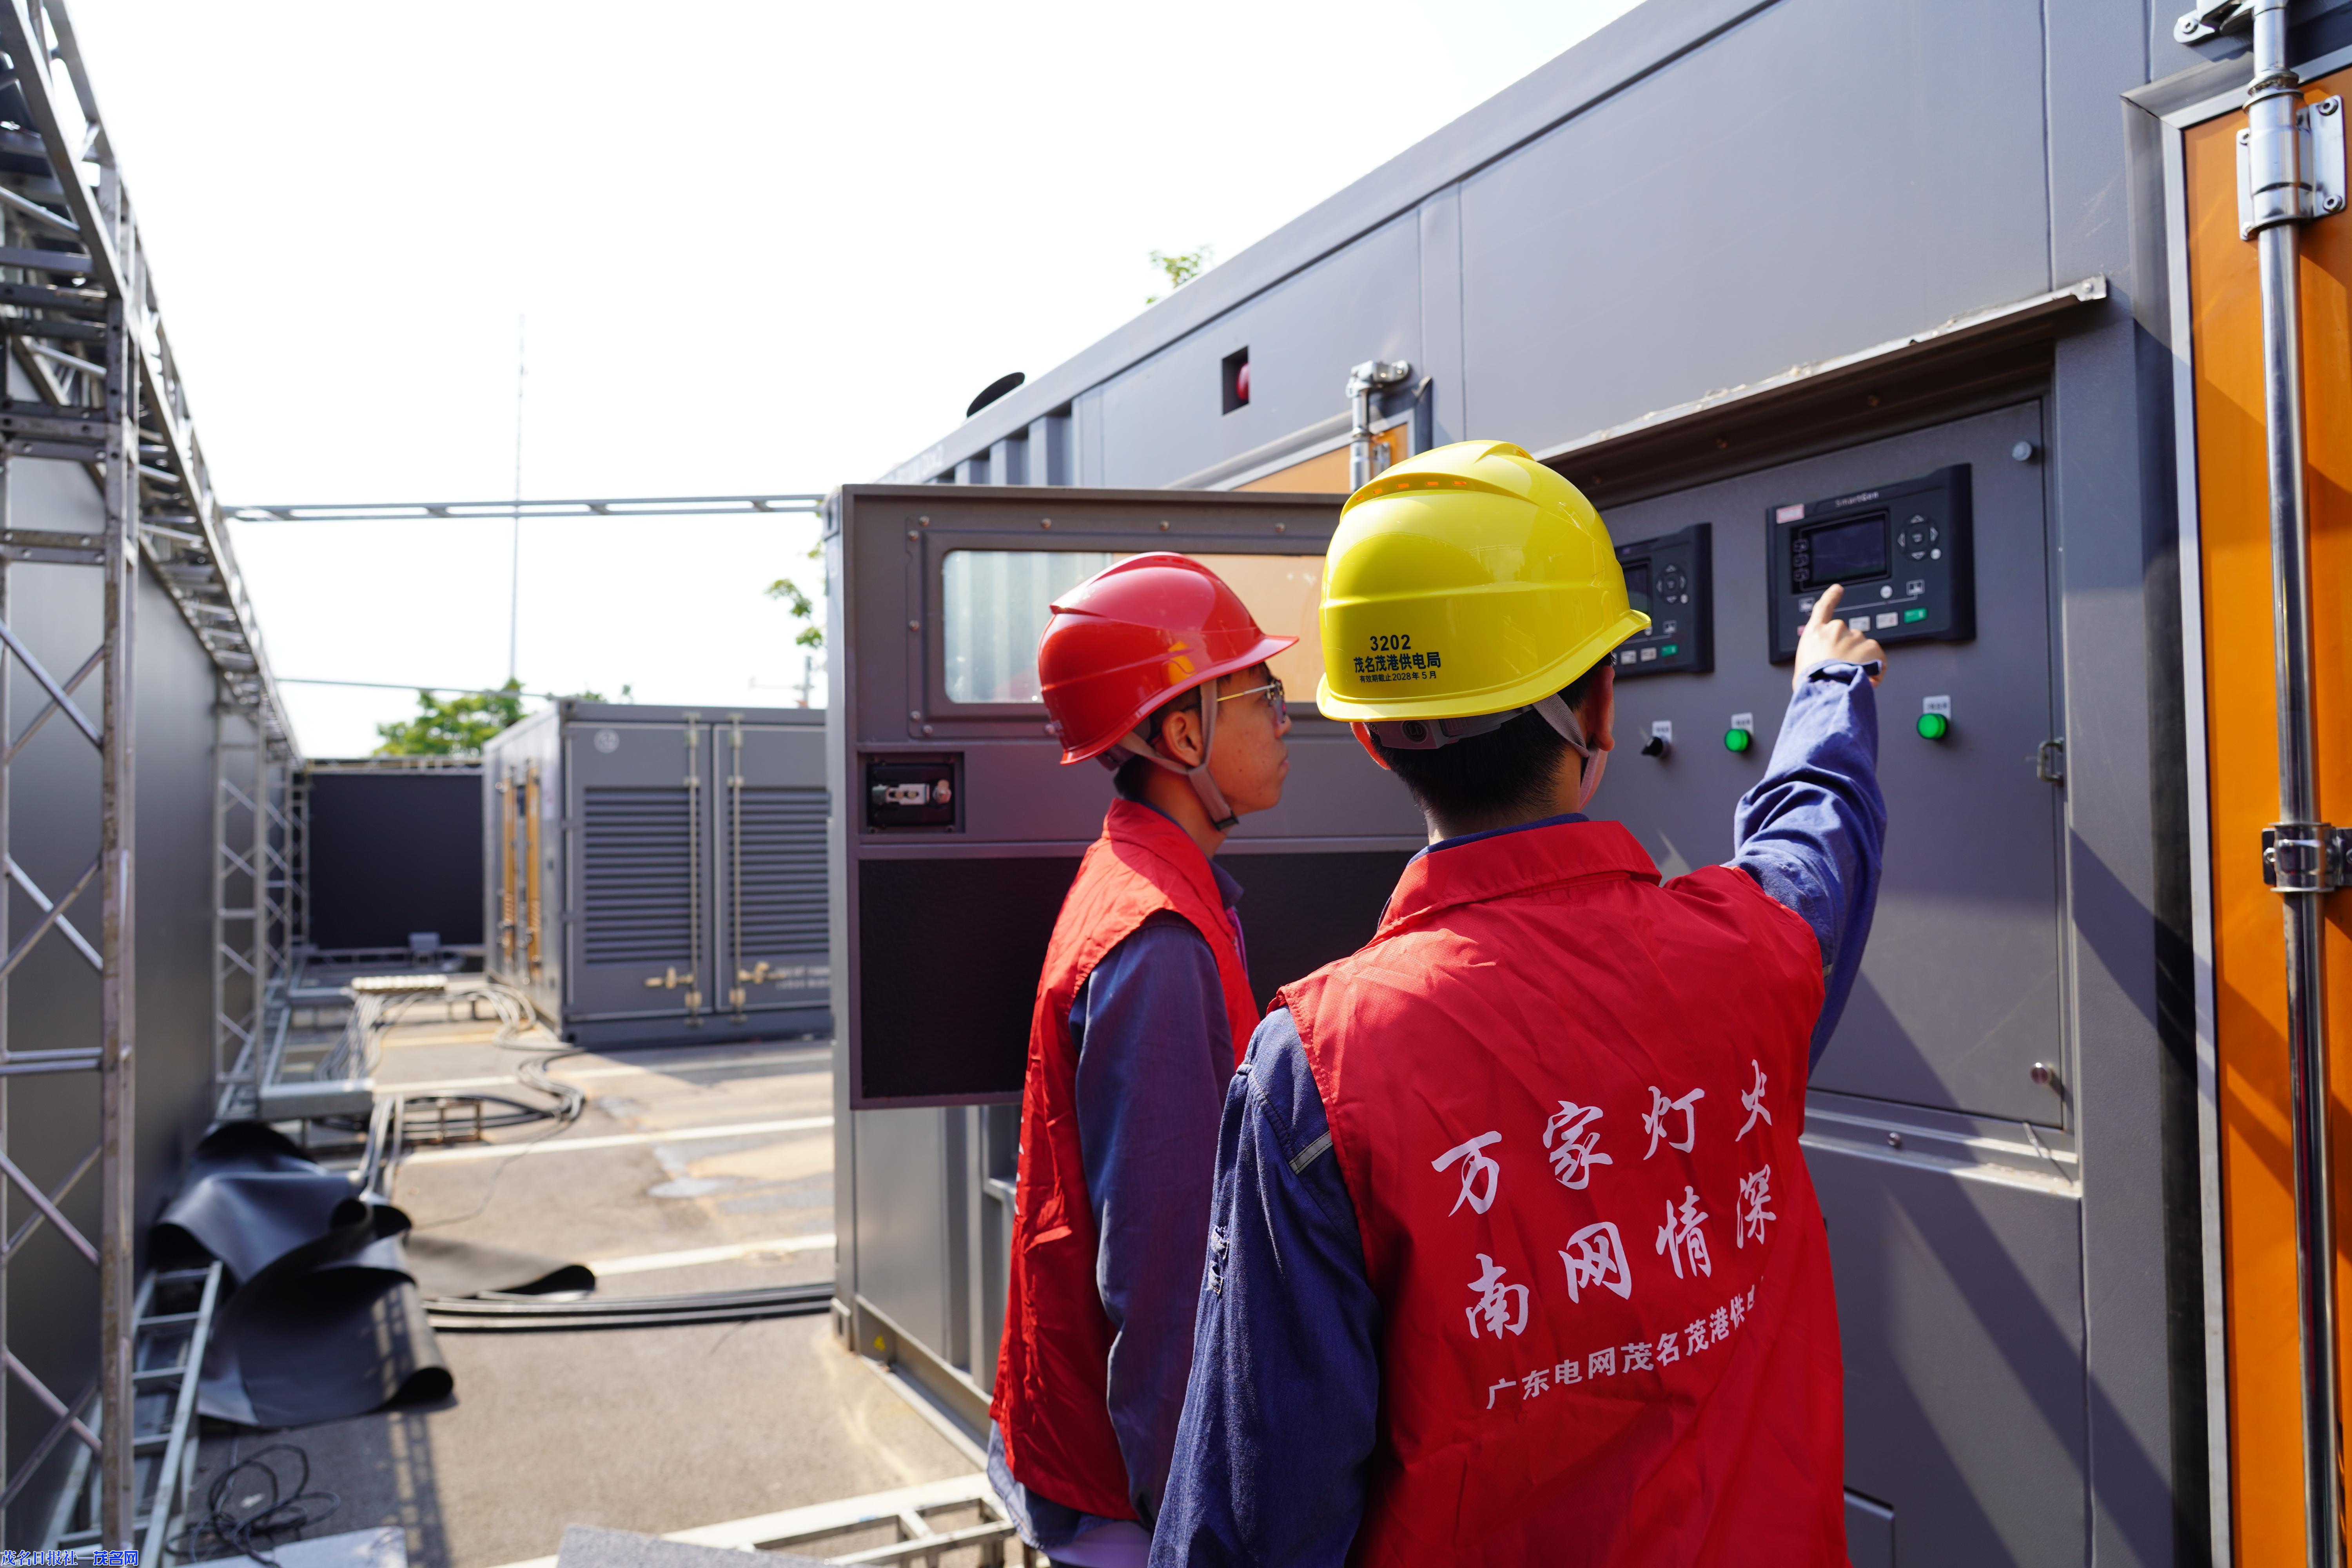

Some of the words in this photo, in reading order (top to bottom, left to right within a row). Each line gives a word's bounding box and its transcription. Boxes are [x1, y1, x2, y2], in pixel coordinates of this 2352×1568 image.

[1353, 652, 1441, 673] 茂名茂港供电局
[1370, 634, 1411, 651] 3202
[1431, 1059, 1772, 1217] 万家灯火
[1465, 1164, 1777, 1340] 南网情深
[1486, 1276, 1763, 1409] 广东电网茂名茂港供
